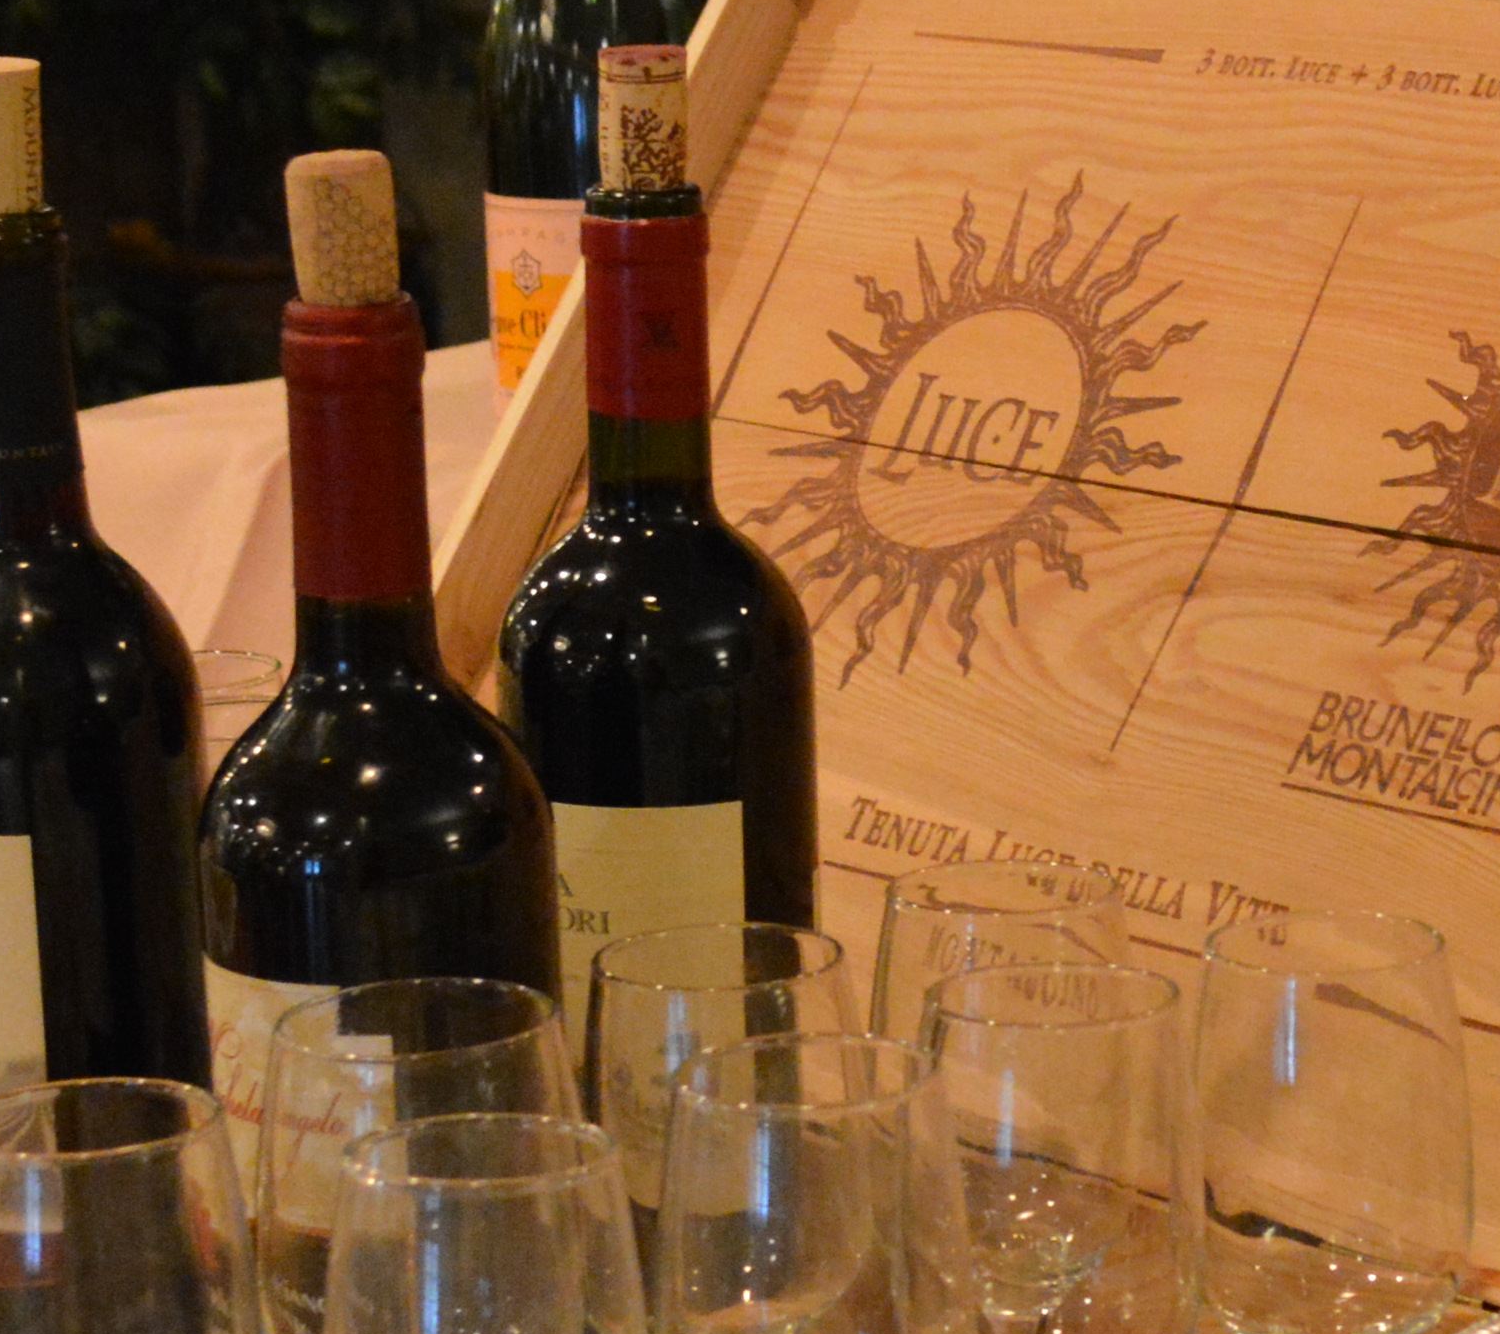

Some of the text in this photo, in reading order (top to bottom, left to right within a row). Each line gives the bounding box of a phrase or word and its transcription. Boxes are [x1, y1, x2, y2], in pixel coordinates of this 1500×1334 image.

[1196, 48, 1216, 75] 3
[1376, 63, 1397, 91] 3
[866, 372, 1060, 486] LUCE
[843, 795, 972, 865] TENUTA
[1206, 880, 1291, 931] VITE
